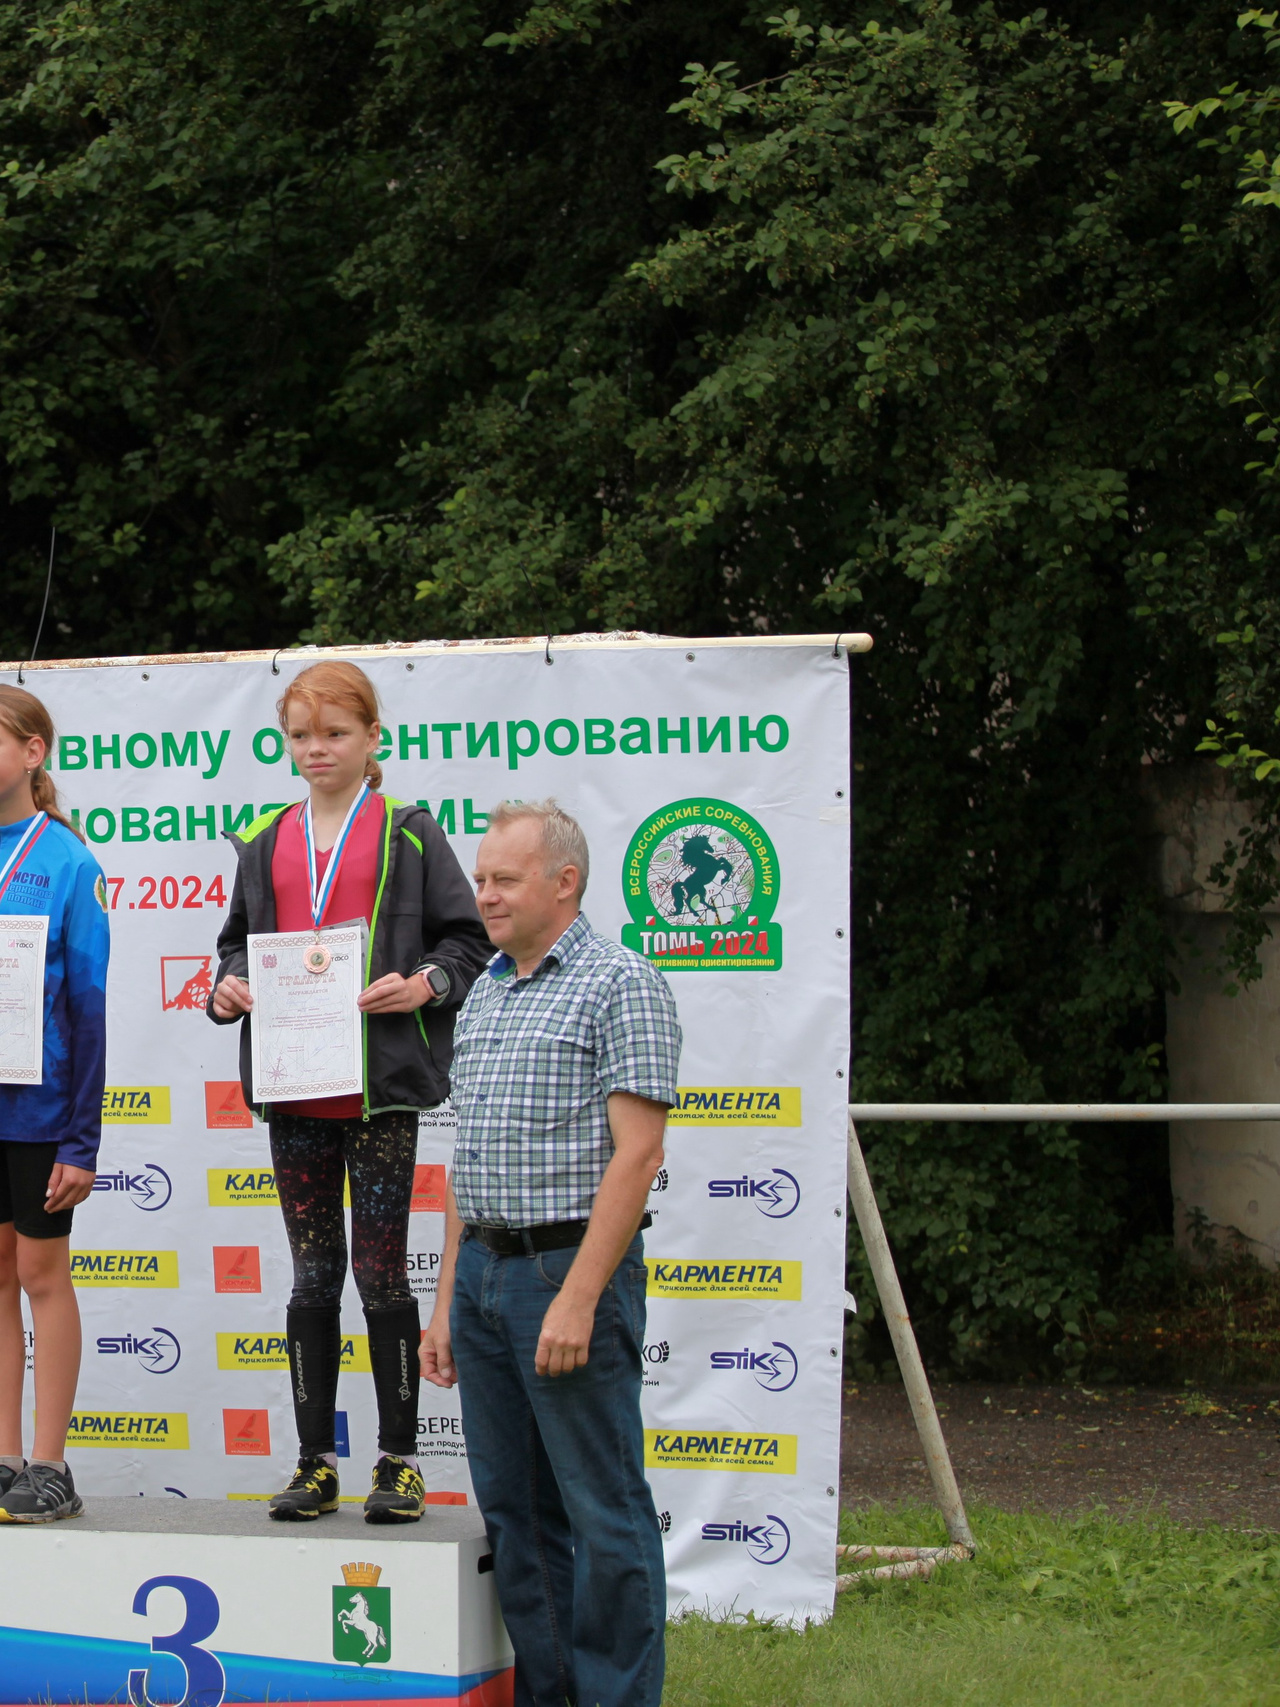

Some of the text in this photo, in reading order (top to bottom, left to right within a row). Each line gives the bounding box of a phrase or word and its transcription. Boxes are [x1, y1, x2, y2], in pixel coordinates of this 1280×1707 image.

[630, 805, 773, 896] ВСЕРОССИЙСКИЕ СОРЕВНОВАНИЯ
[640, 930, 769, 956] ТОМЬ 2024
[278, 972, 336, 986] ГРАМОТА
[675, 1092, 781, 1110] АРМЕНТА
[707, 1111, 725, 1120] для
[70, 1255, 159, 1273] РМЕНТА
[654, 1264, 783, 1283] КАРМЕНТА
[658, 1284, 707, 1292] трикотаж
[709, 1283, 726, 1292] для
[728, 1284, 750, 1292] всей
[69, 1416, 169, 1434] АРМЕНТА
[104, 1434, 118, 1442] для
[120, 1434, 138, 1442] всей
[653, 1435, 778, 1457] КАРМЕНТА
[657, 1455, 774, 1466] трикотаж для всей семьи
[127, 1574, 226, 1706] 3
